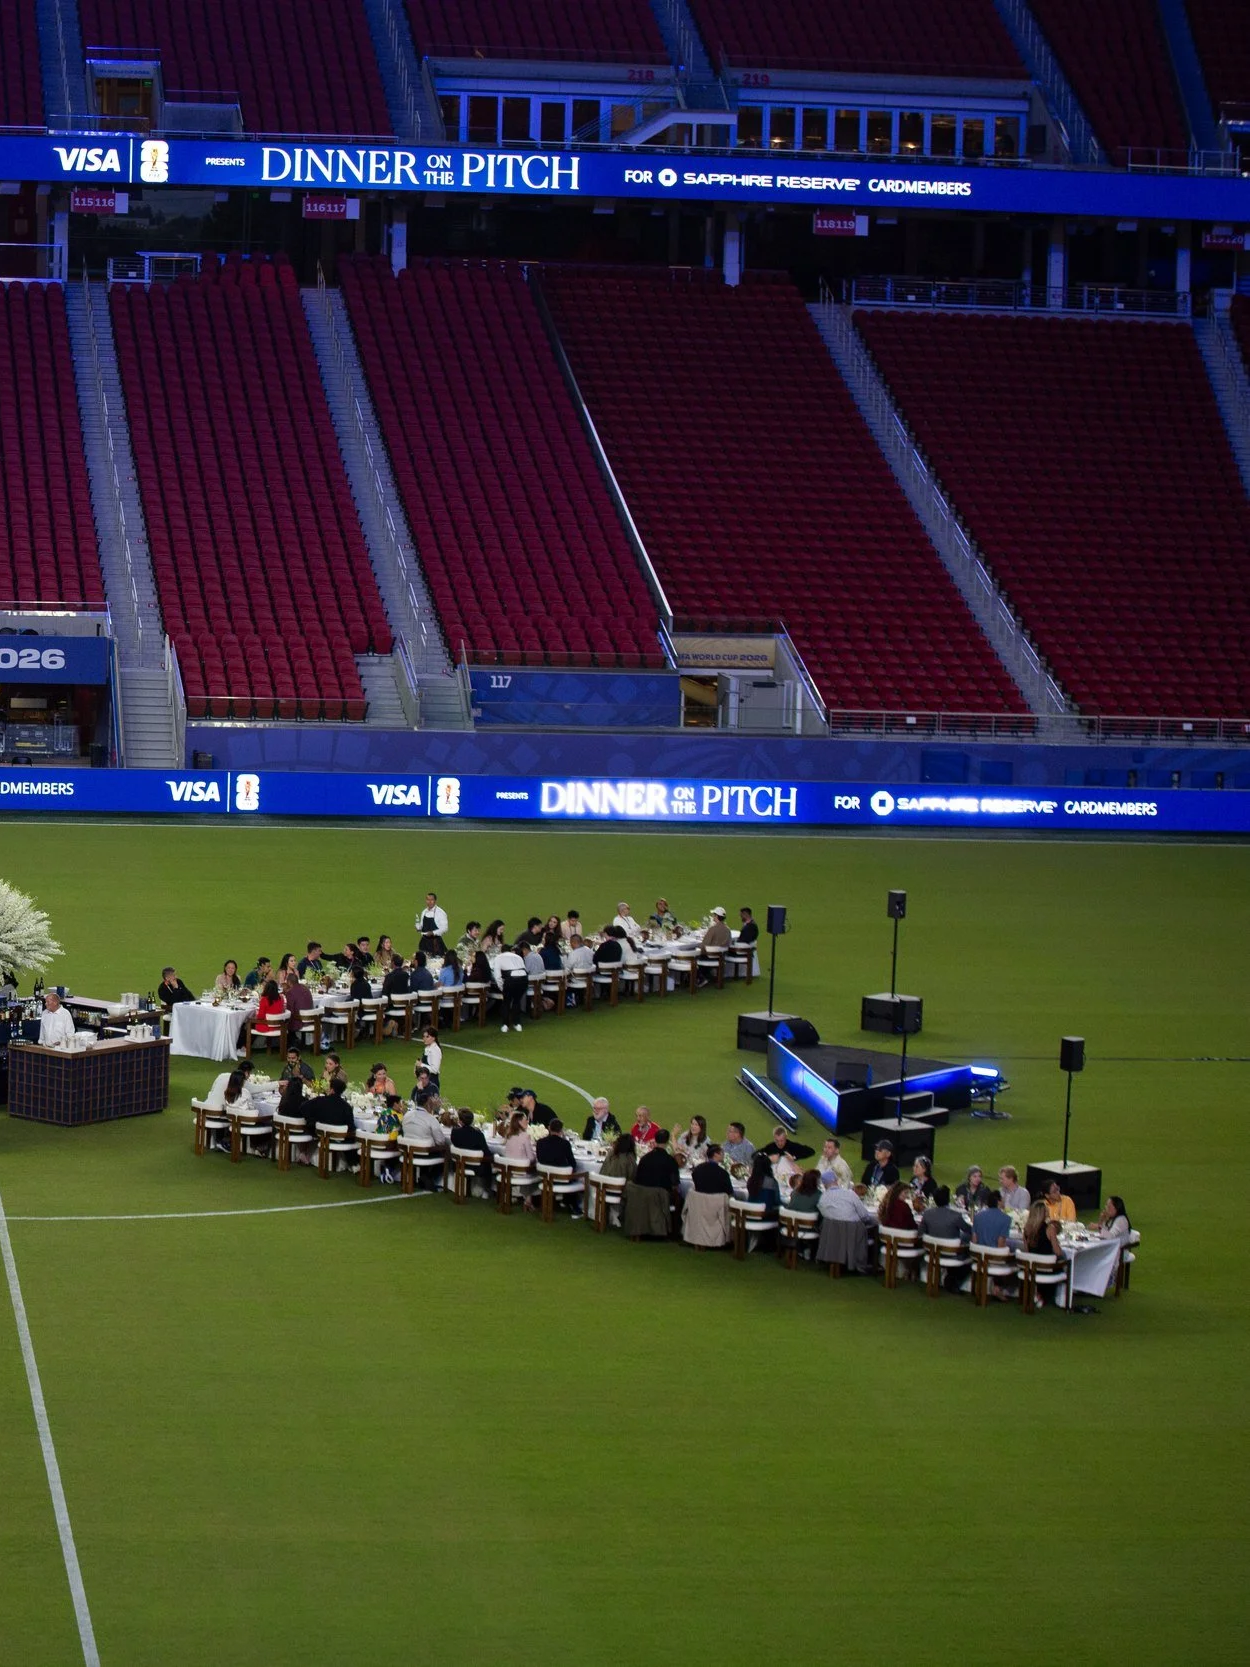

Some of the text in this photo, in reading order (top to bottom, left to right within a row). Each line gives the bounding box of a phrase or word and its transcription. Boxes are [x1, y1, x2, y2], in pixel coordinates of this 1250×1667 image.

[53, 147, 121, 173] VISA
[205, 157, 246, 167] PRESENTS
[261, 147, 420, 185] DINNER
[426, 154, 452, 169] ON
[423, 170, 455, 186] THE
[461, 153, 580, 190] PITCH
[624, 169, 653, 184] FOR
[683, 172, 773, 188] SAPPHIRE
[868, 178, 972, 196] CARDMEMBERS
[74, 197, 115, 207] 115 116
[306, 203, 346, 213] 116 117
[836, 220, 855, 230] 119
[692, 653, 721, 661] WORLD
[722, 653, 738, 661] CUP
[740, 654, 768, 662] 2026
[490, 675, 512, 689] 117
[166, 781, 221, 802] VISA
[366, 784, 422, 806] VISA
[496, 791, 529, 800] PRESENTS
[540, 782, 669, 816] DINNER
[673, 787, 695, 800] ON
[670, 801, 697, 815] THE
[701, 785, 798, 817] PITCH
[834, 795, 861, 810] FOR
[897, 796, 979, 812] SAPPHIRE
[1064, 800, 1158, 816] CARDMEMBERS
